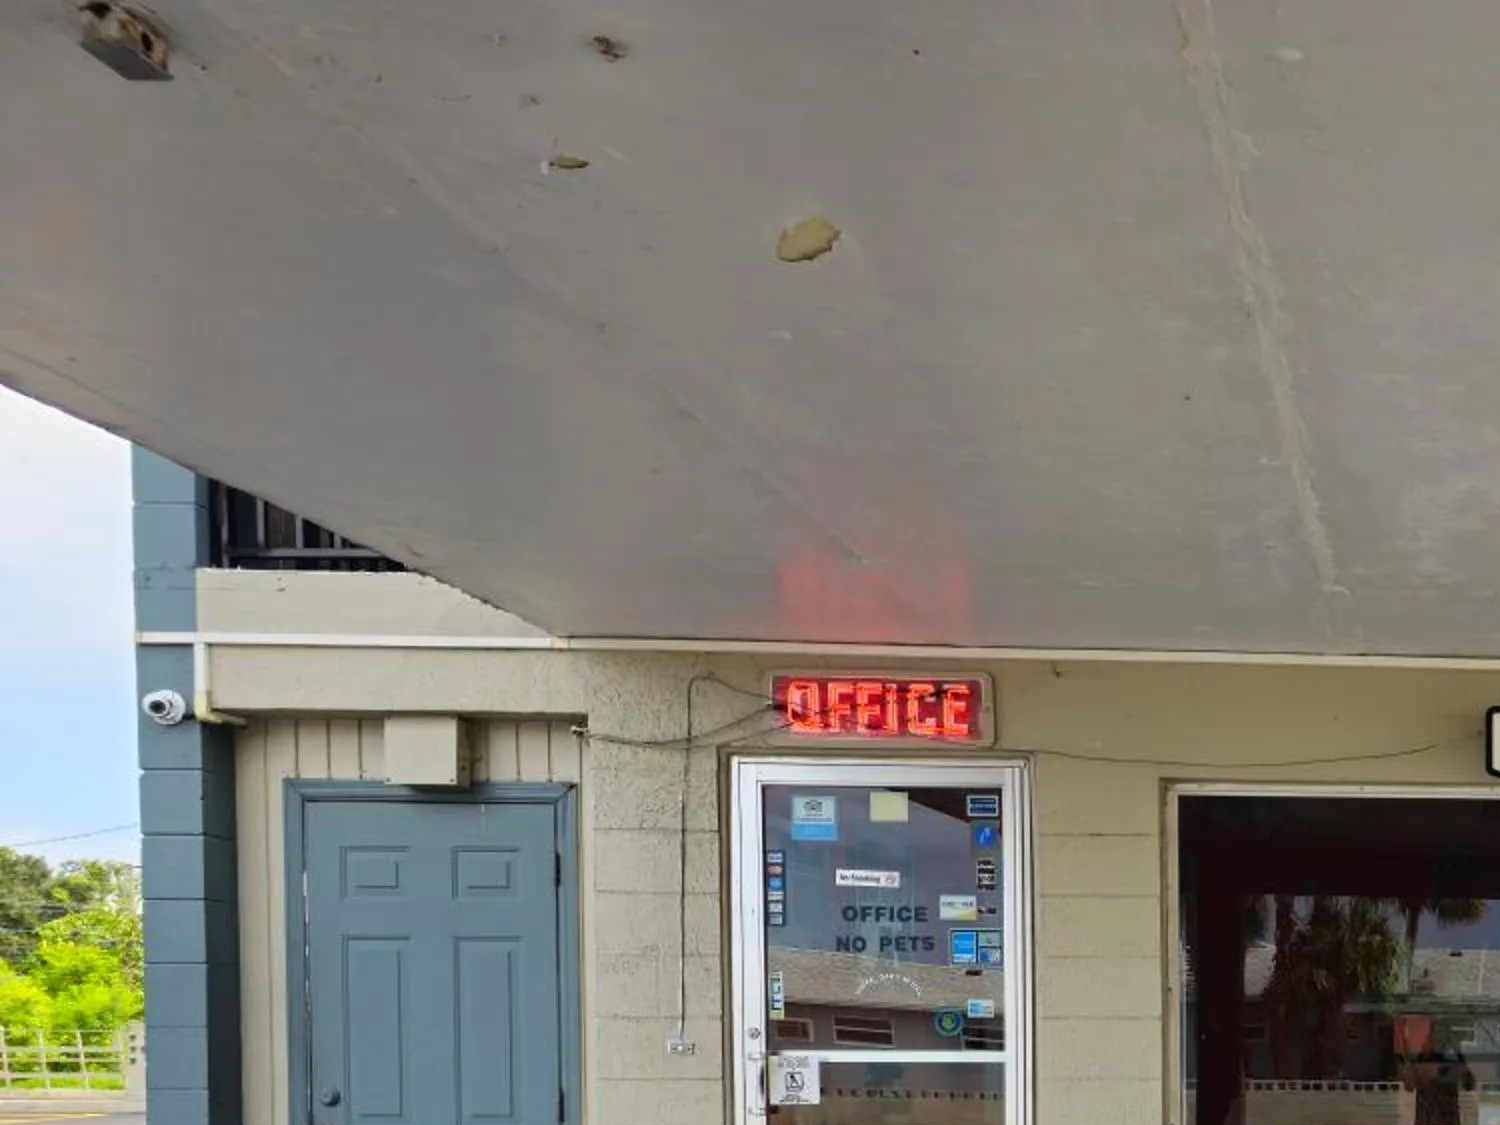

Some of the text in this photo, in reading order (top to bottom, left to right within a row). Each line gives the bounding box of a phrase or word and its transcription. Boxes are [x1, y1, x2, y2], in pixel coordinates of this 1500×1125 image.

[786, 681, 971, 739] OFFICE
[841, 905, 929, 923] OFFICE
[835, 936, 867, 953] NO
[879, 935, 935, 952] PETS
